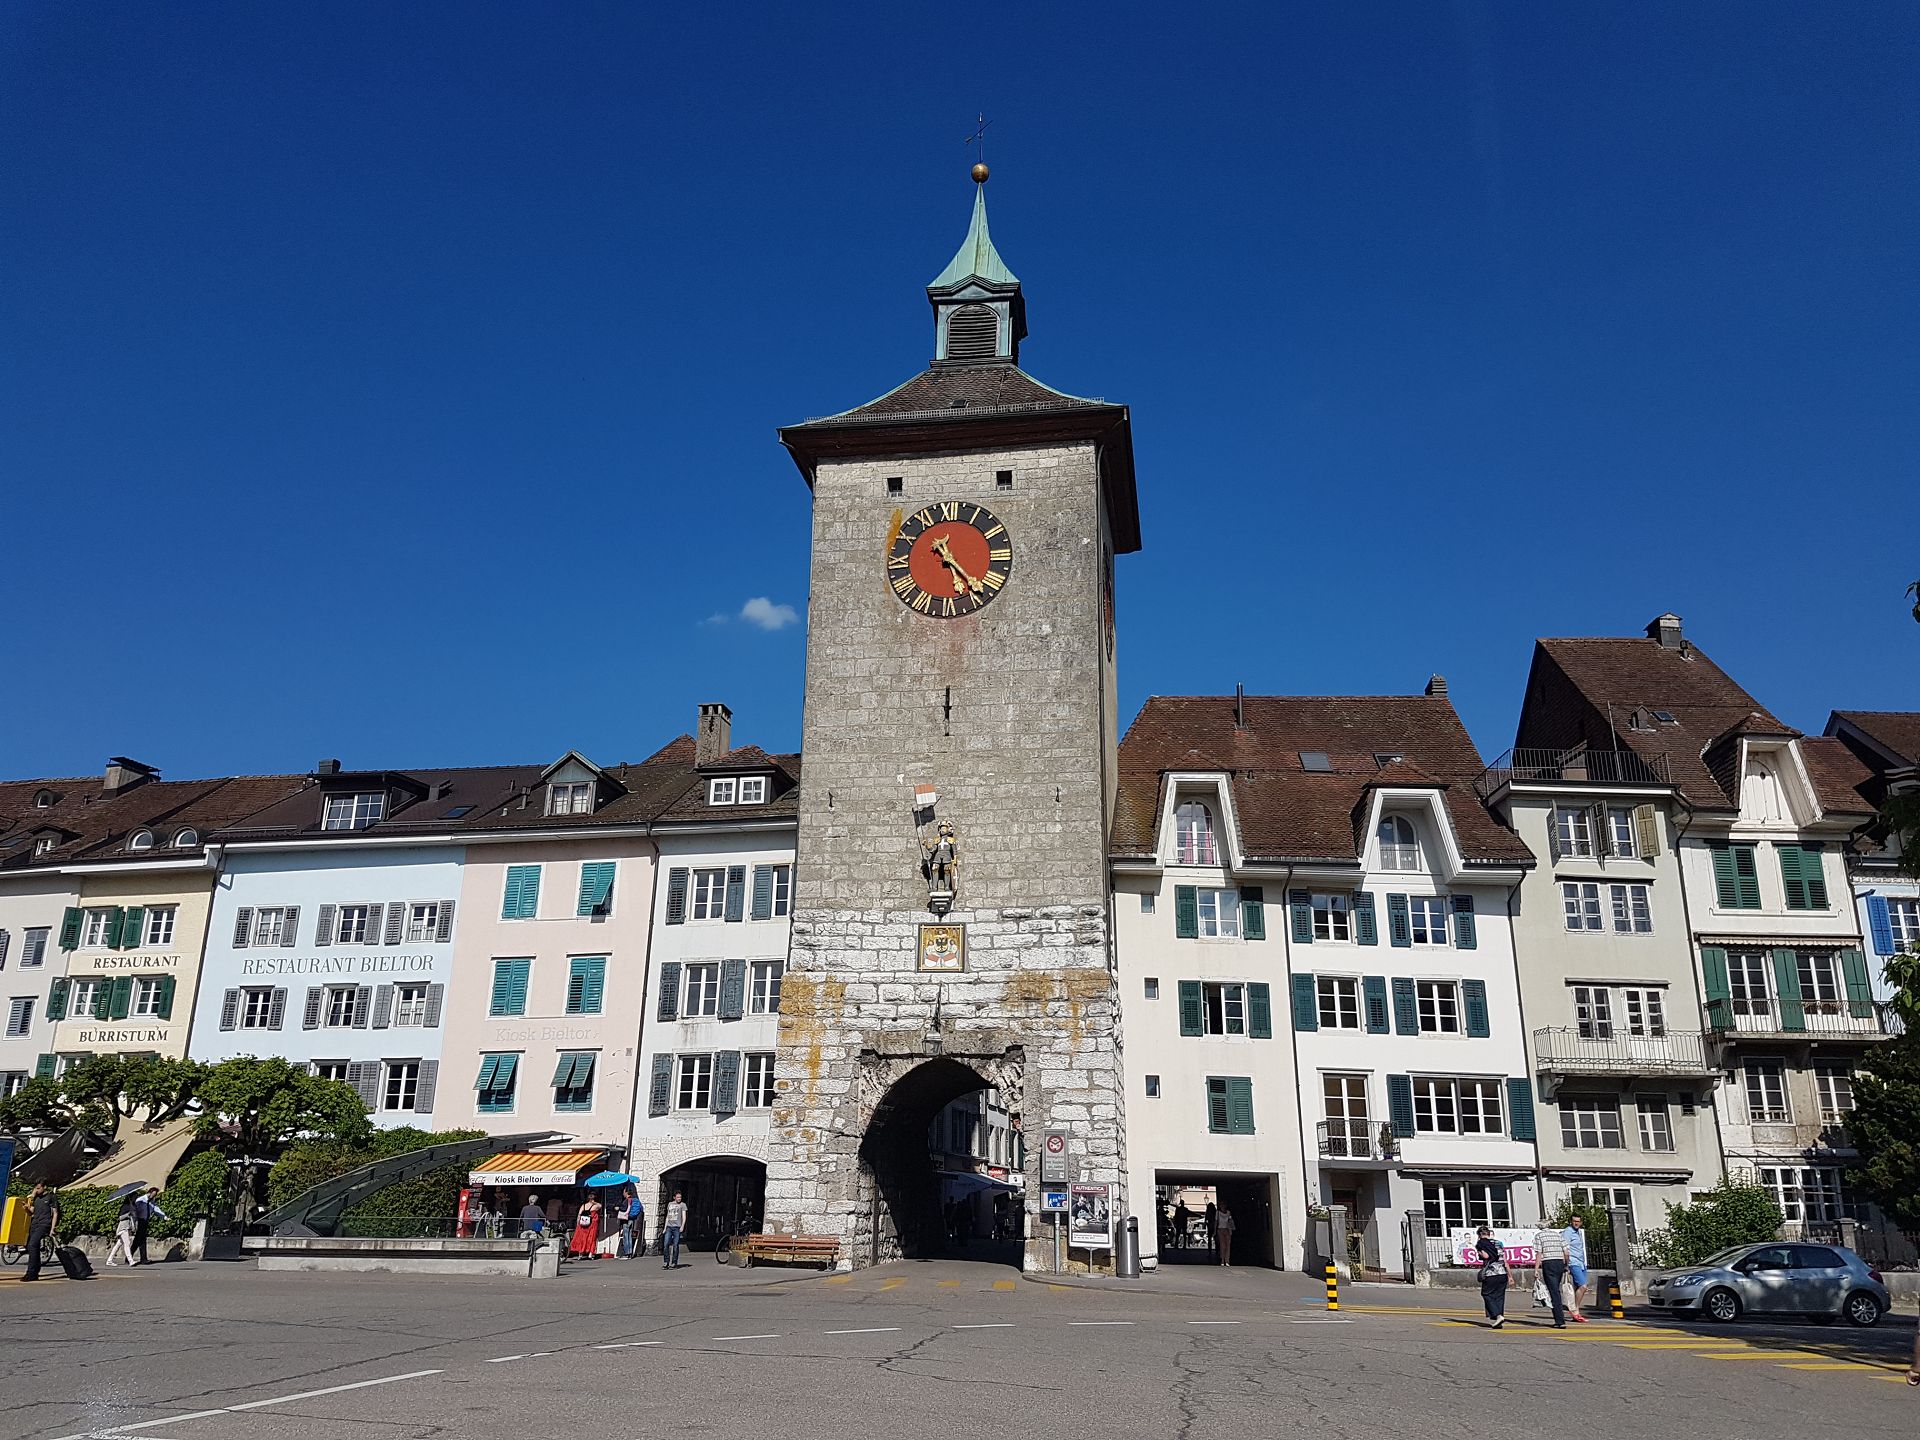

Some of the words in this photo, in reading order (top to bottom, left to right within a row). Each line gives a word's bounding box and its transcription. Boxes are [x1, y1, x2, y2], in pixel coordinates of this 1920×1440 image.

[941, 501, 959, 521] XII
[969, 507, 980, 524] I
[914, 508, 935, 531] XI
[896, 529, 917, 546] X
[984, 524, 1004, 540] II
[888, 554, 909, 570] IX
[990, 548, 1011, 561] III
[942, 597, 957, 617] VI
[93, 955, 180, 969] RESTAURANT
[242, 957, 356, 975] RESTAURANT
[360, 954, 434, 973] BIELTOR
[496, 1027, 537, 1042] Kiosk
[541, 1026, 592, 1041] Bieltor
[494, 1175, 516, 1184] Kiosk
[517, 1175, 544, 1183] Bieltor
